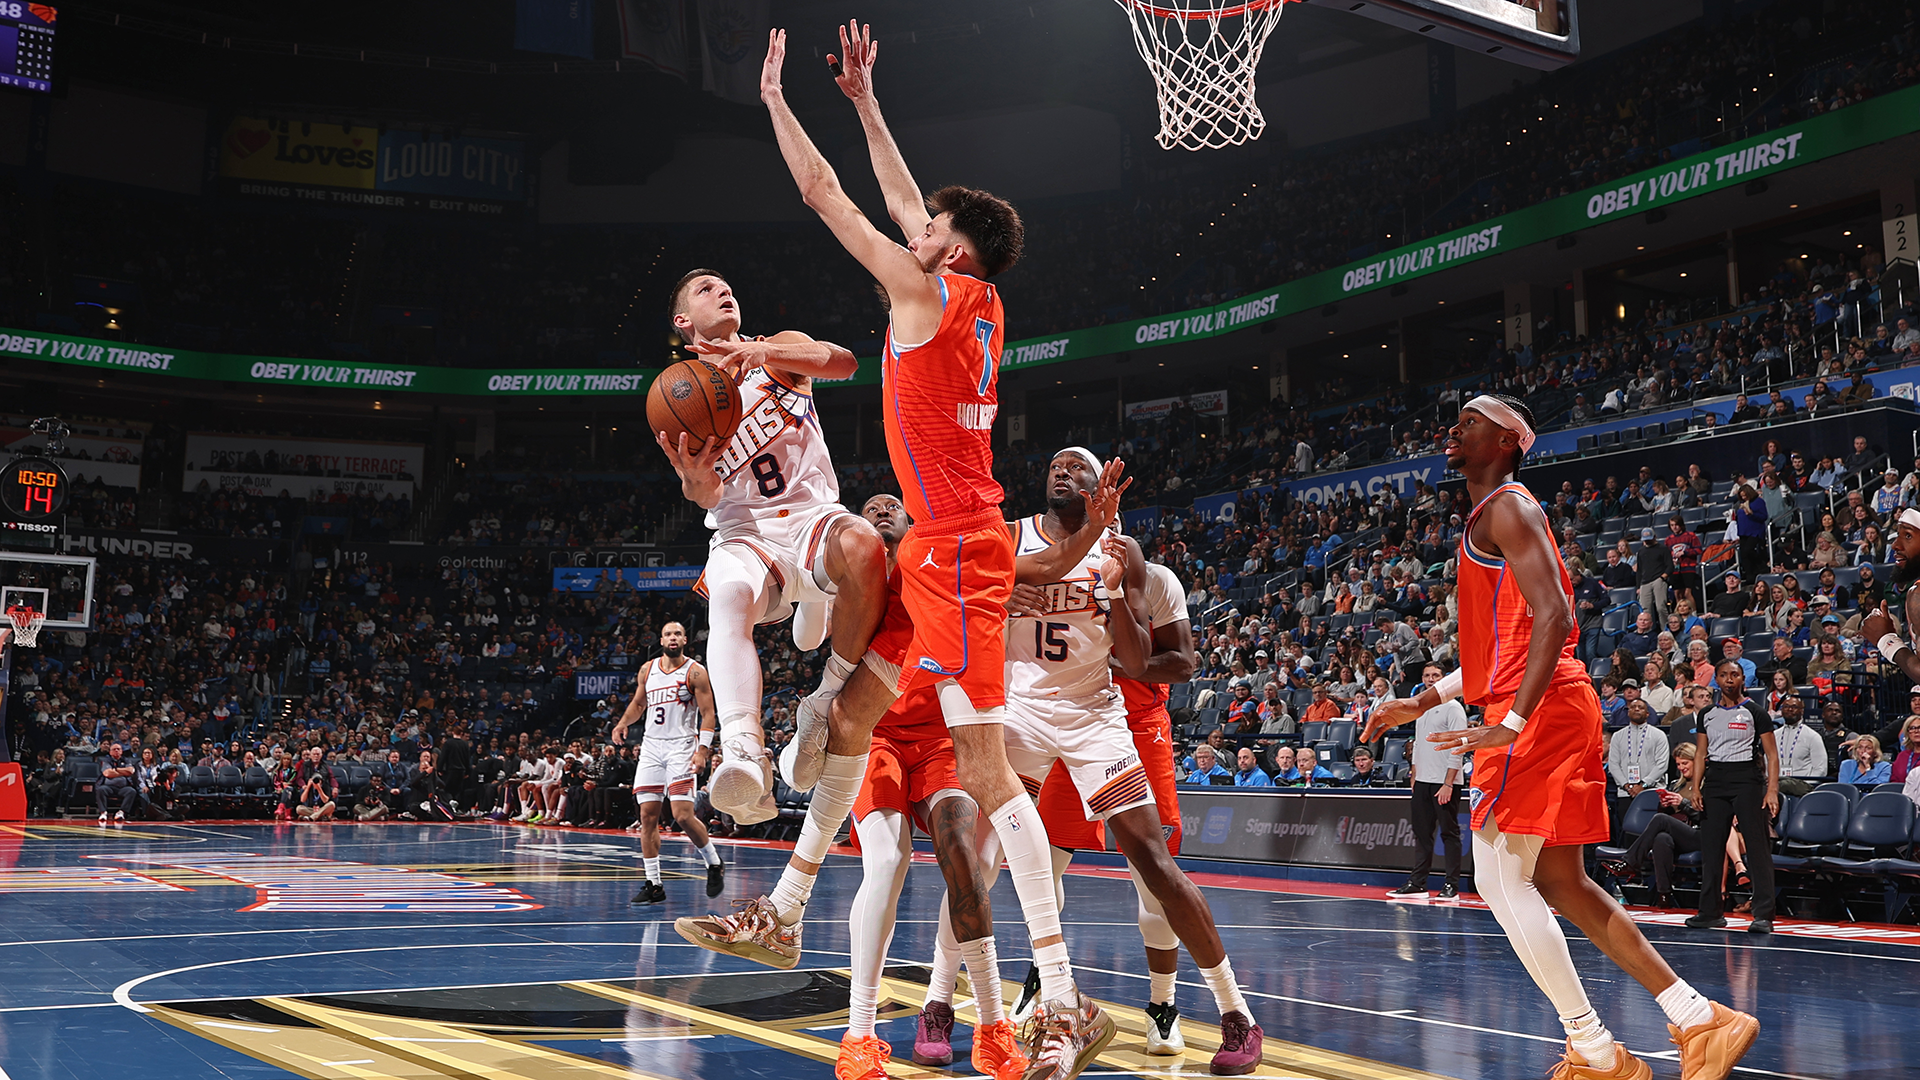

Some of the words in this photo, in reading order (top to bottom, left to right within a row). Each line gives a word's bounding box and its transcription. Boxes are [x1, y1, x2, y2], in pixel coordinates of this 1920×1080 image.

[383, 142, 452, 182] LOUD
[462, 144, 519, 191] CITY
[1587, 181, 1646, 219] OBEY
[1648, 162, 1711, 201] YOUR
[1714, 132, 1803, 181] THIRST
[240, 184, 290, 197] BRING
[295, 188, 326, 200] THE
[330, 191, 405, 206] THUNDER
[429, 200, 464, 210] EXIT
[468, 203, 503, 214] NOW
[1895, 203, 1907, 251] 222
[1342, 261, 1387, 292] OBEY
[1388, 246, 1436, 279] YOUR
[1437, 225, 1503, 263] THIRST
[1135, 319, 1182, 344] OBEY
[1182, 310, 1228, 336] YOUR
[1228, 294, 1280, 325] THIRST
[0, 333, 50, 355] OBEY
[49, 341, 105, 362] YOUR
[107, 347, 174, 370] THIRST
[974, 316, 997, 397] 7
[1016, 338, 1069, 364] THIRST
[250, 362, 301, 380] OBEY
[301, 364, 352, 383] YOUR
[353, 367, 416, 387] THIRST
[488, 374, 534, 391] OBEY
[531, 374, 582, 392] YOUR
[583, 374, 642, 391] THIRST
[17, 469, 58, 488] 10:50
[344, 456, 407, 475] TERRACE
[750, 452, 788, 500] 8
[220, 475, 243, 488] POST
[254, 477, 272, 488] OAK
[333, 480, 356, 491] POST
[25, 486, 53, 513] 14
[16, 522, 58, 533] TISSOT
[43, 533, 193, 560] THUNDER
[637, 579, 670, 588] CLEANING
[638, 571, 657, 579] YOUR
[1035, 620, 1070, 663] 15
[654, 706, 666, 725] 3
[1245, 818, 1272, 837] Sign
[1272, 822, 1290, 838] up
[1290, 823, 1318, 836] now
[1345, 817, 1396, 850] League
